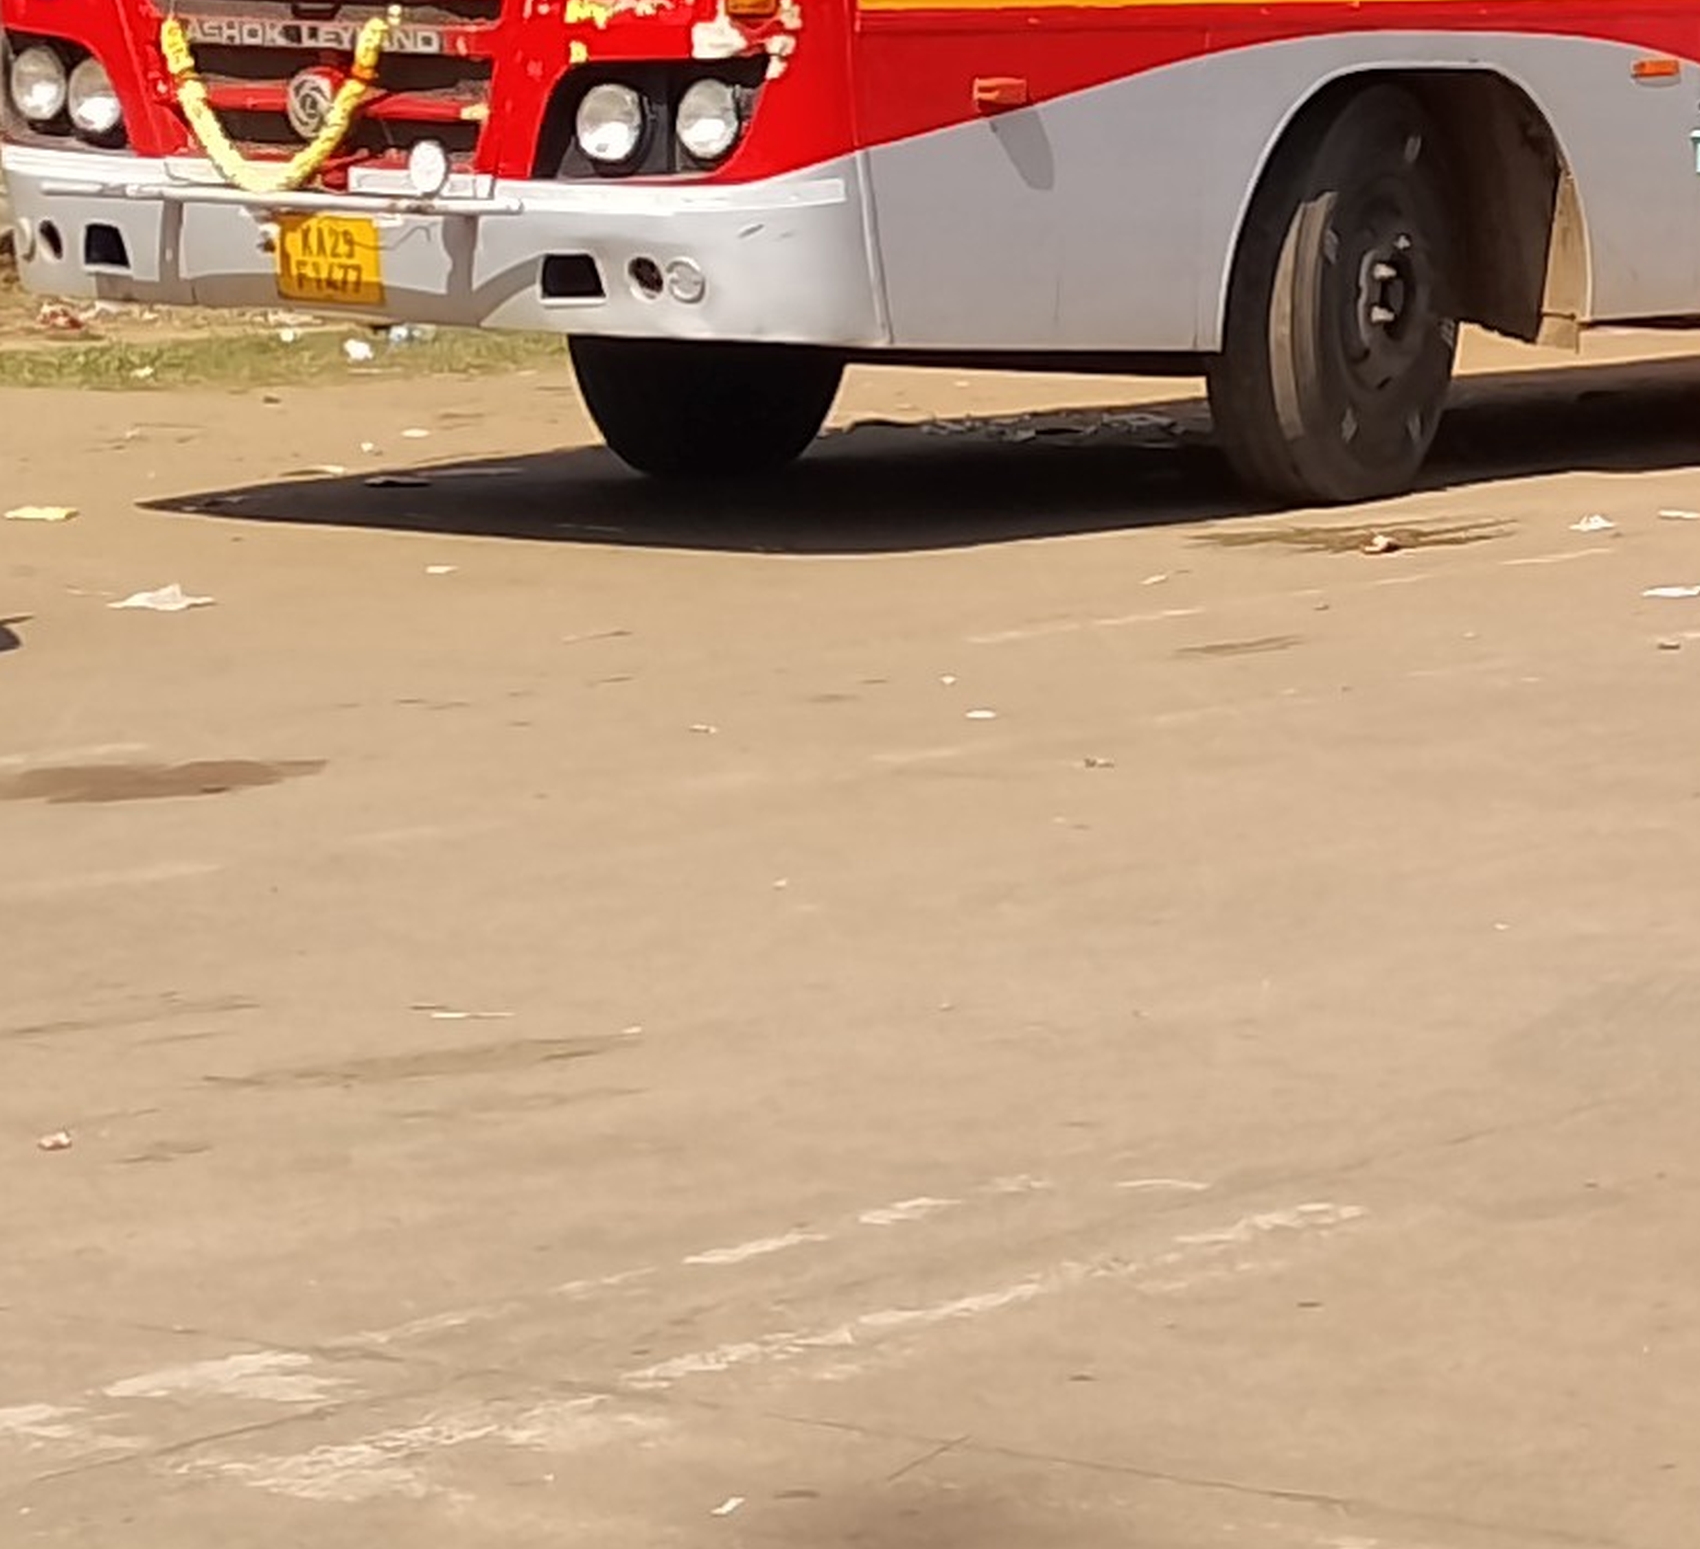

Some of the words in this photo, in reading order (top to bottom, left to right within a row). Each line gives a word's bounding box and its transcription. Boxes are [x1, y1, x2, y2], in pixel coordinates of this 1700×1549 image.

[188, 18, 284, 48] ASHOK
[301, 23, 441, 55] LEYND
[301, 224, 356, 260] KA29
